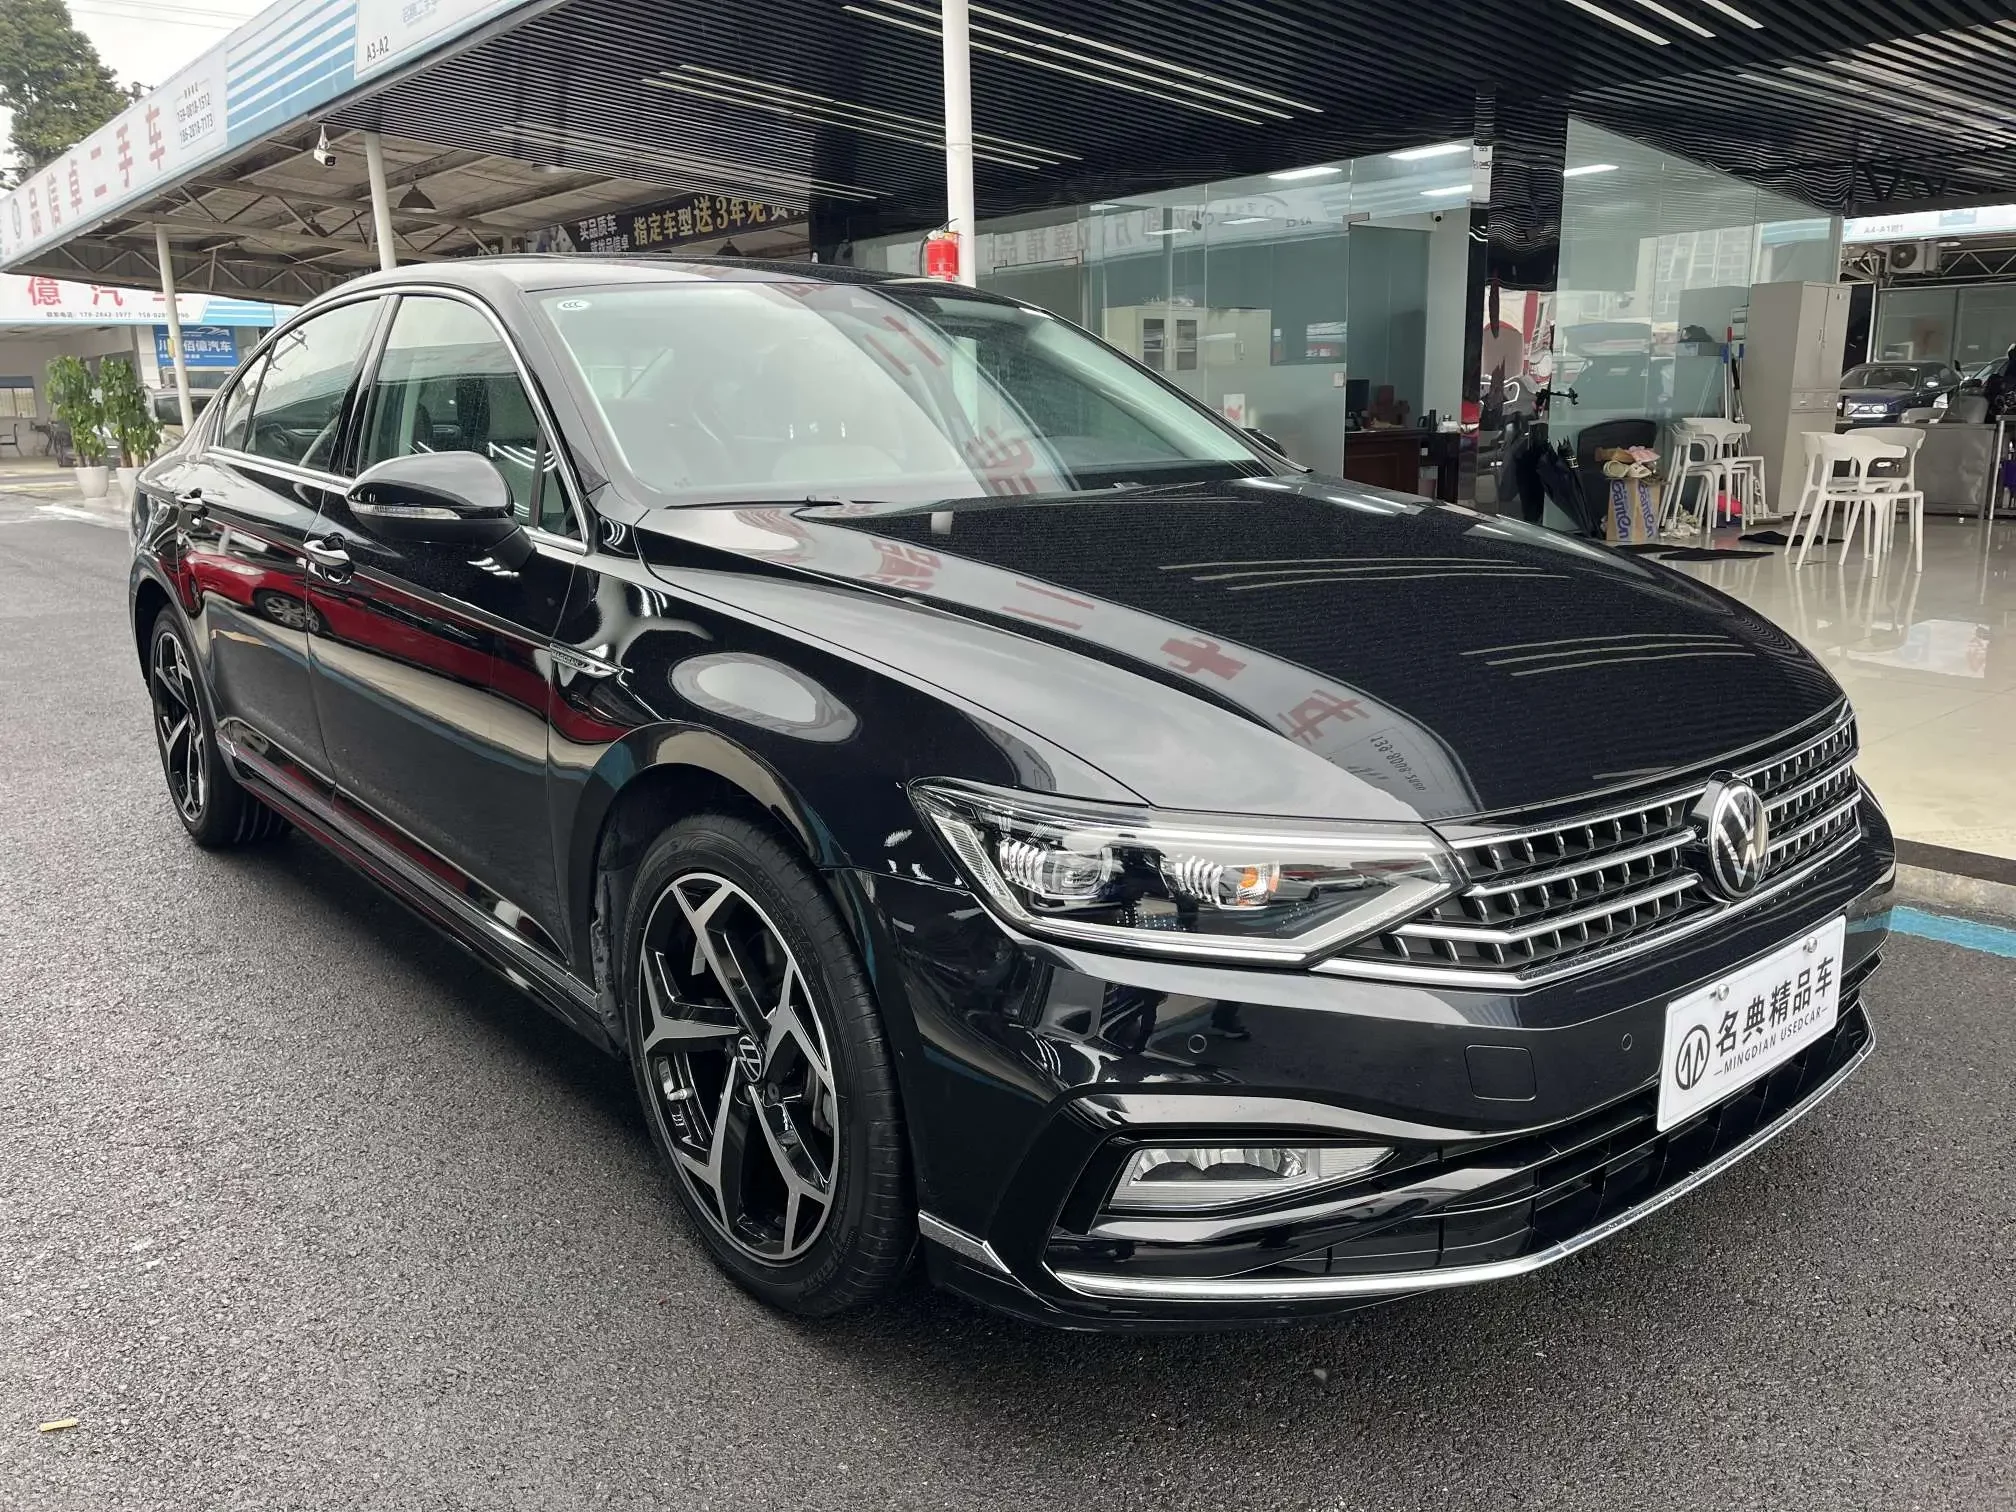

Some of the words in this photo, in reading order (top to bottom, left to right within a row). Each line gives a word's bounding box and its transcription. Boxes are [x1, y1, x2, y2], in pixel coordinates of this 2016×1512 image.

[1716, 956, 1834, 1058] 名典精品车
[1724, 1034, 1777, 1075] MINGDIAN
